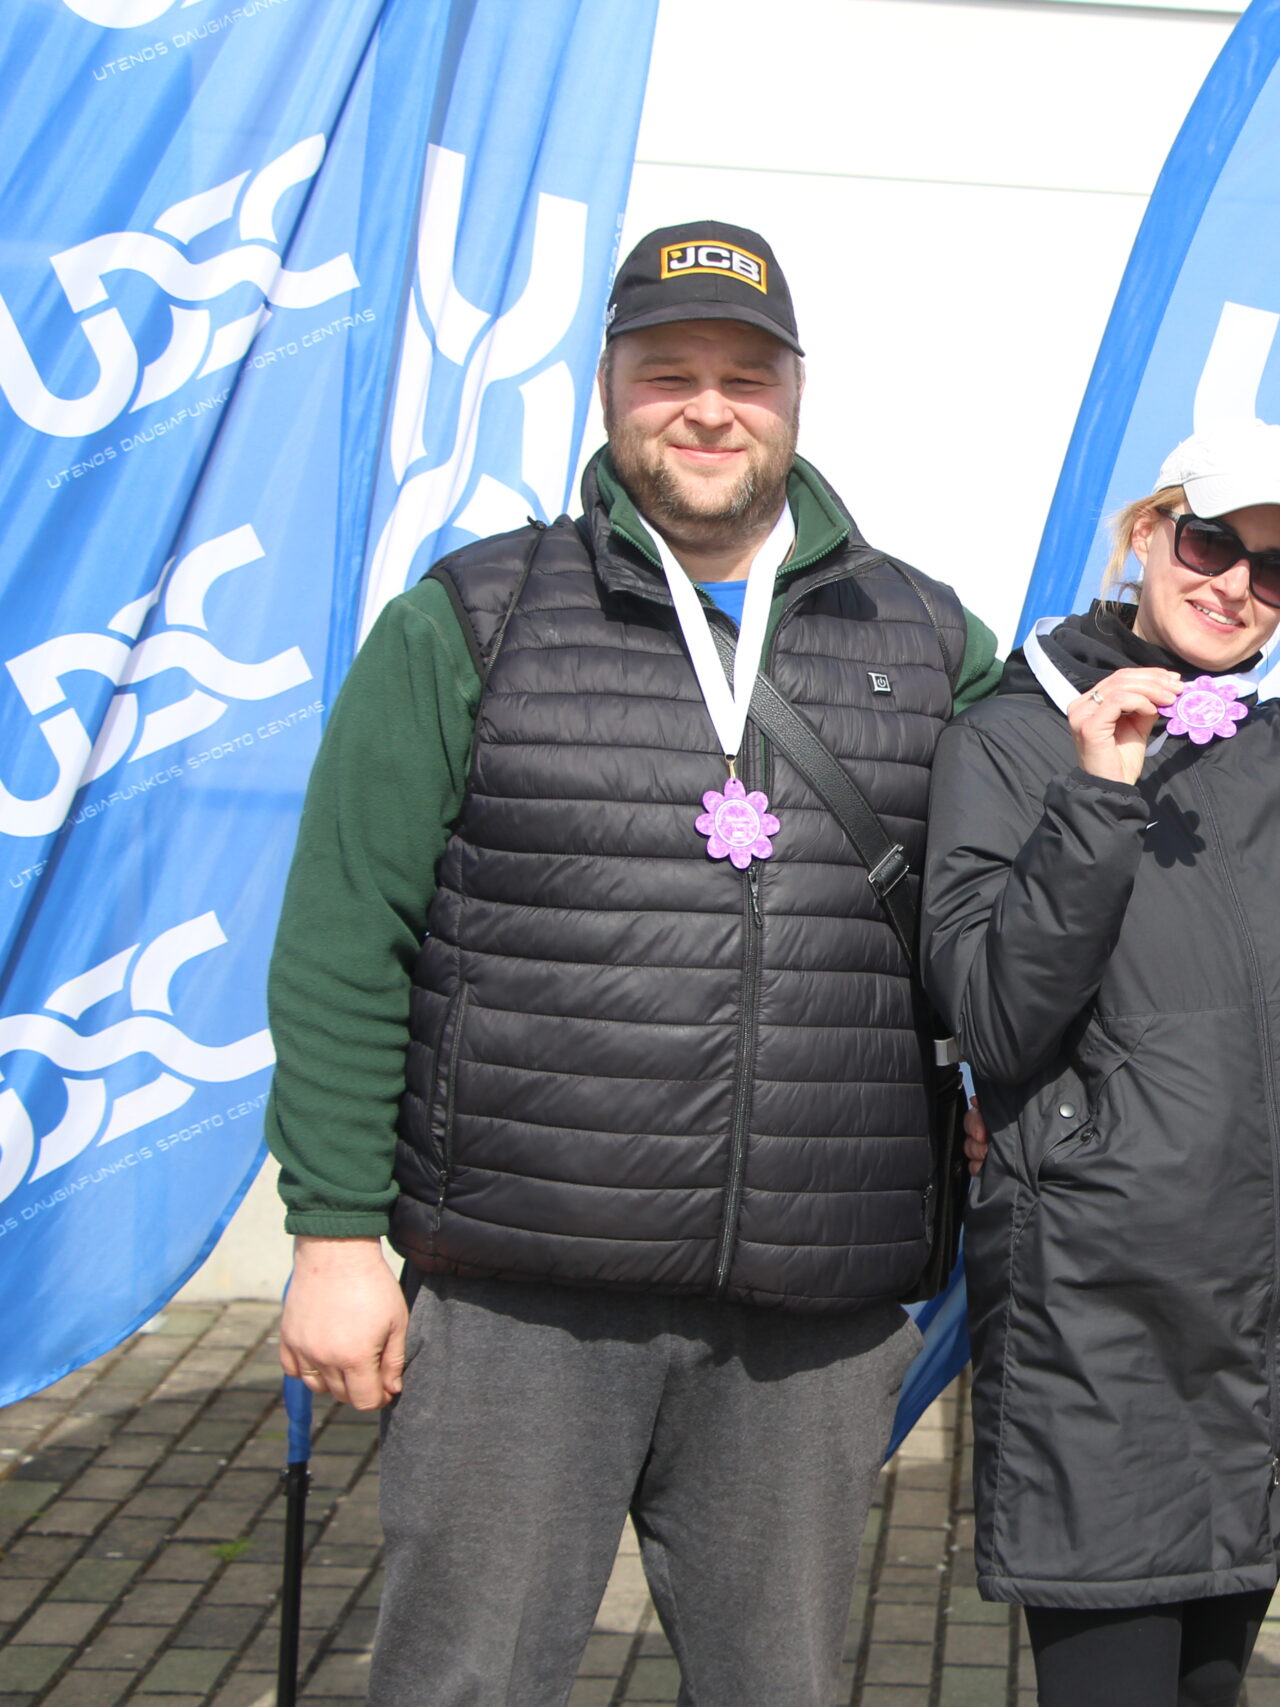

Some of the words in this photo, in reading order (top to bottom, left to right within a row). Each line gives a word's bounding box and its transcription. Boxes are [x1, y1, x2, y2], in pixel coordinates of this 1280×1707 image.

[93, 41, 169, 81] UTENOS
[669, 246, 761, 283] JCB
[46, 446, 117, 489] UTENOS
[302, 307, 376, 349] CENTRAS
[8, 859, 48, 889] UTE
[186, 732, 255, 771] SPORTO
[256, 700, 327, 740] CENTRAS
[20, 1146, 154, 1222] DAUGIAFUNKCIS
[156, 1113, 225, 1152] SPORTO
[226, 1090, 271, 1121] CENT
